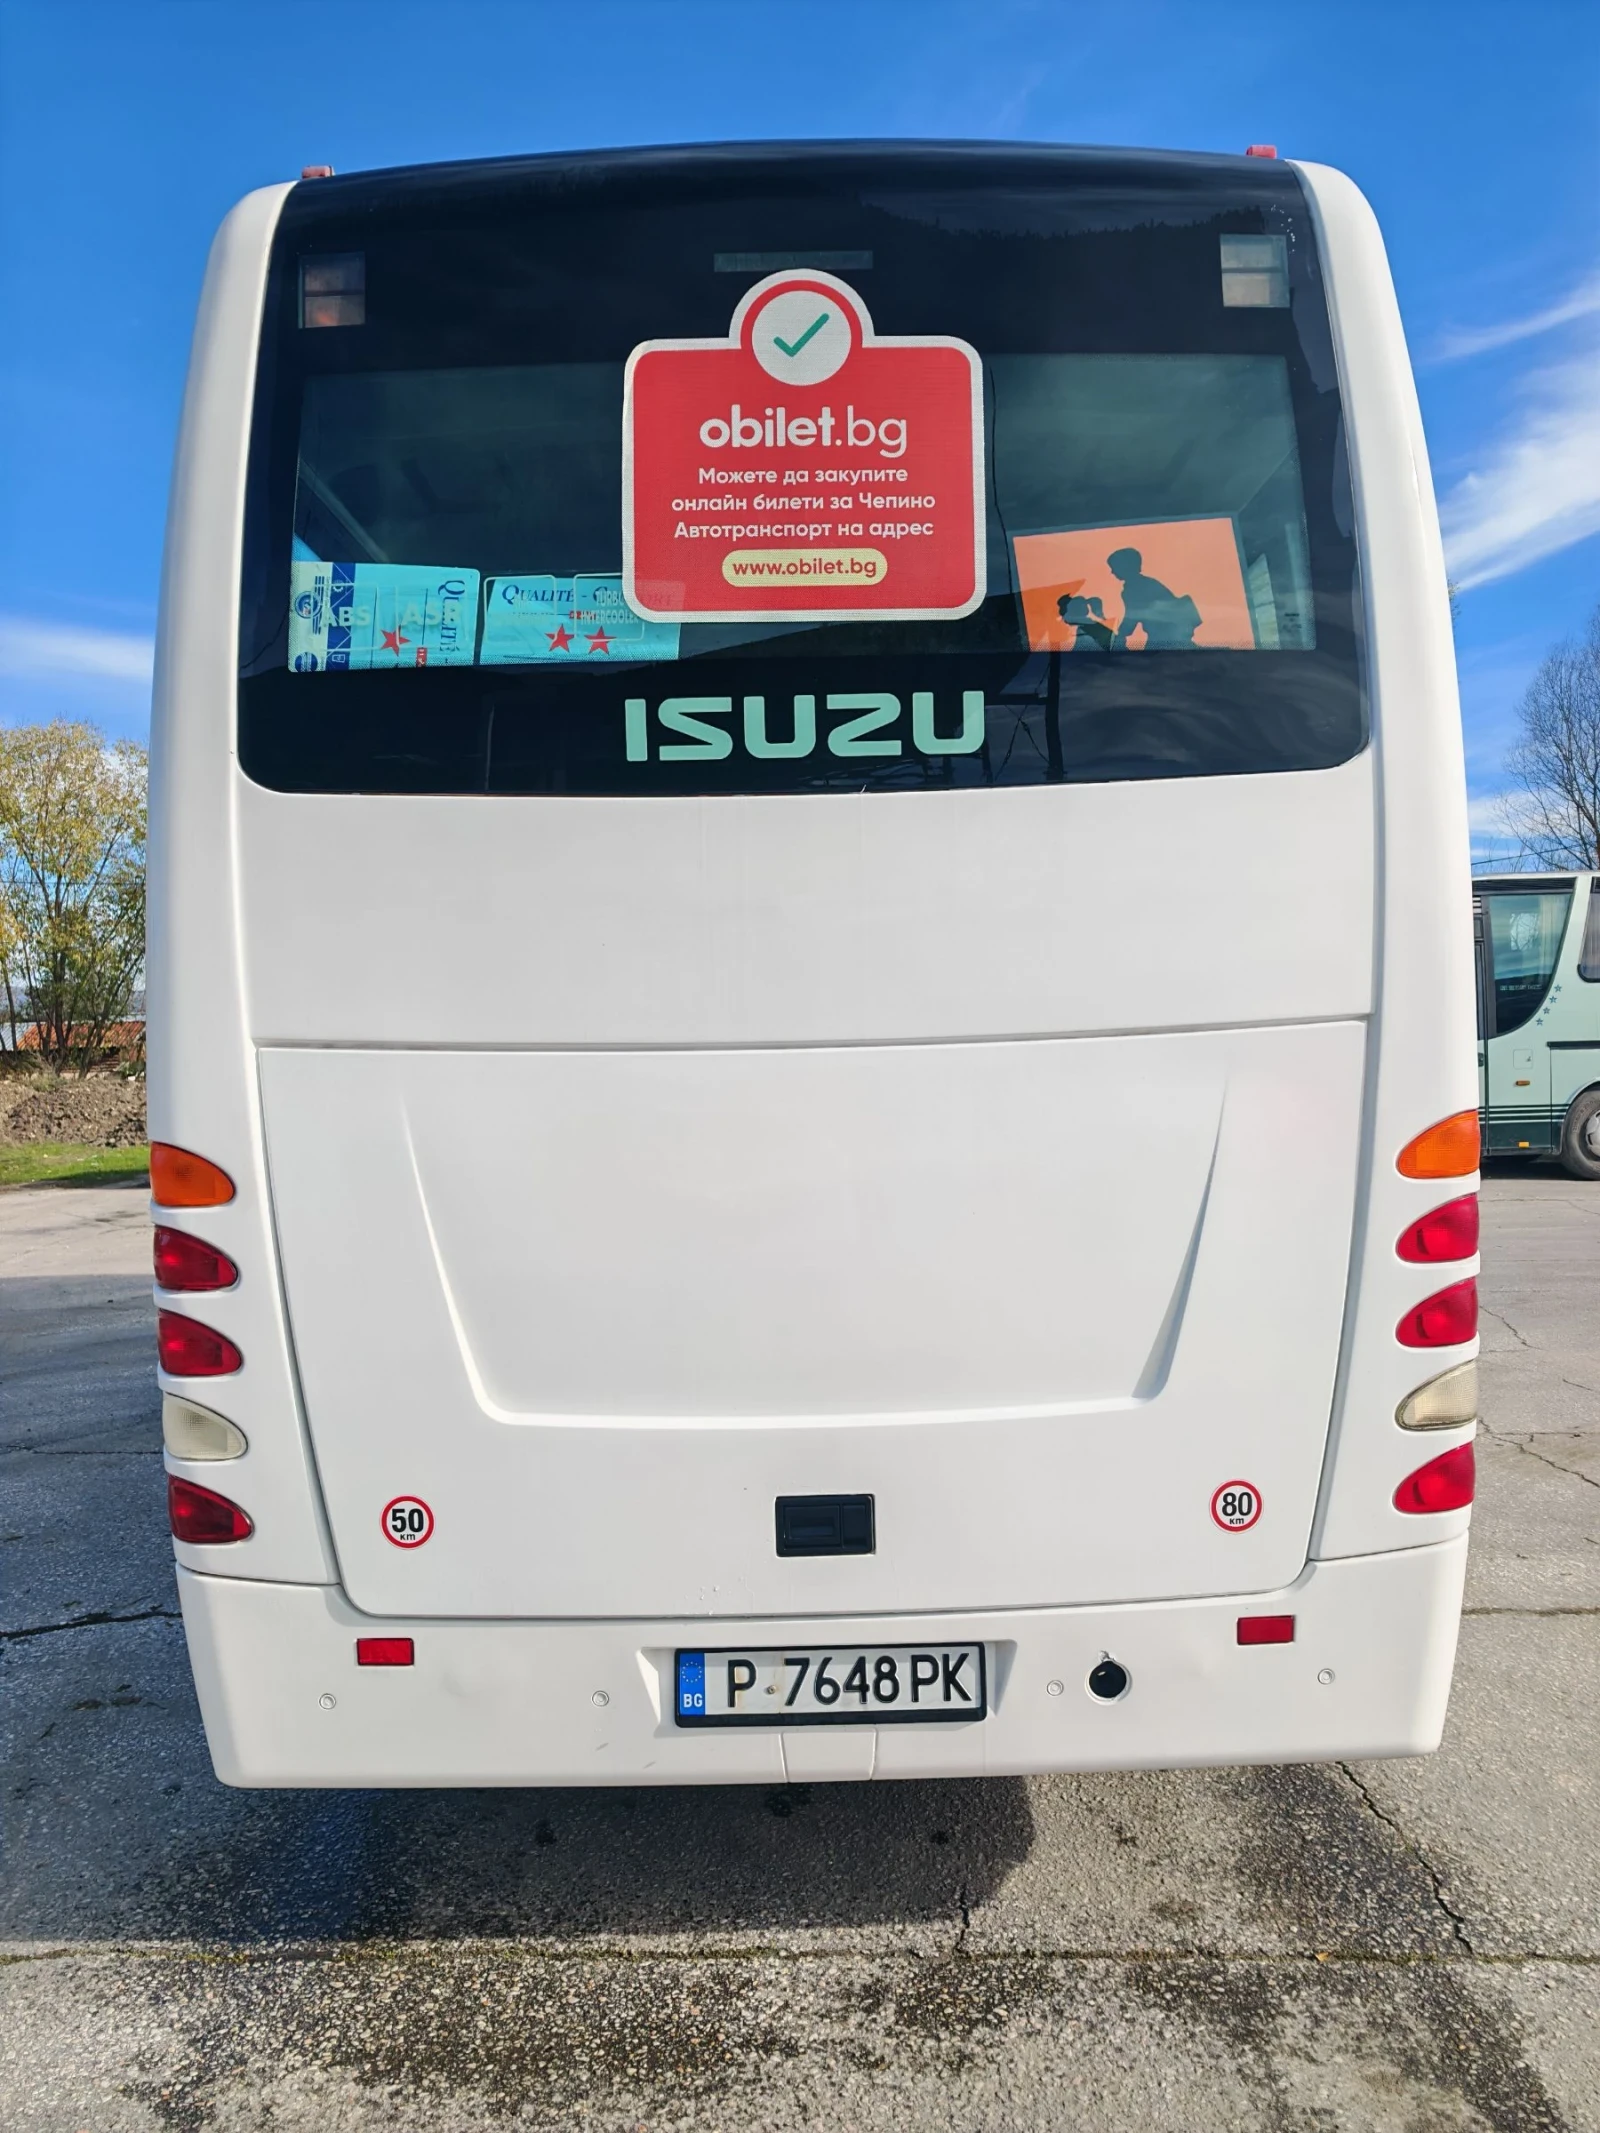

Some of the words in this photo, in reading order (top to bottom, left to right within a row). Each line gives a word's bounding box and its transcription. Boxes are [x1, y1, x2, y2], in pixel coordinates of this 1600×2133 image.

[699, 404, 907, 458] obilet.bg
[698, 467, 778, 484] Можете
[783, 470, 809, 486] да
[814, 468, 909, 486] закупите
[671, 494, 748, 511] онлайн
[753, 493, 824, 510] билети
[830, 496, 853, 509] за
[858, 492, 936, 509] Чепино
[674, 521, 832, 541] Автотранспорт
[837, 523, 863, 536] на
[869, 522, 934, 540] адрес
[732, 556, 877, 578] www.obilet.bg
[320, 606, 371, 628] ABS
[400, 600, 462, 627] ASR
[624, 690, 985, 762] ISUZU
[1222, 1491, 1253, 1517] 80
[391, 1508, 424, 1533] 50
[683, 1693, 703, 1708] BG
